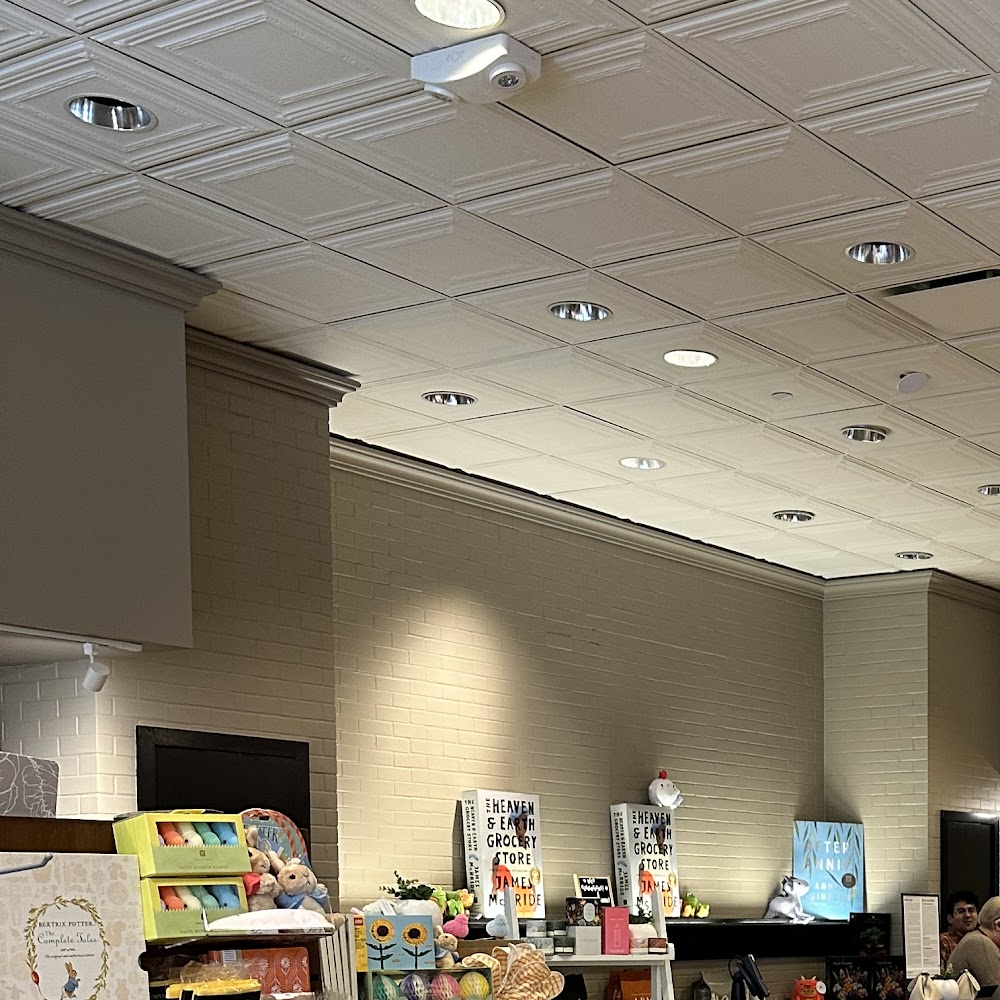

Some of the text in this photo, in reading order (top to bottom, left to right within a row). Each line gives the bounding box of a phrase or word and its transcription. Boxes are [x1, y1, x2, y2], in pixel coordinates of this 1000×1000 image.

[492, 798, 534, 815] HEAVEN
[488, 816, 534, 831] & EARTH
[638, 811, 671, 825] HEAVEN
[634, 828, 640, 838] &
[487, 832, 537, 850] GROCERY
[634, 842, 673, 856] GROCERY
[495, 852, 531, 865] STORE
[640, 858, 670, 871] STORE
[496, 876, 532, 890] JAMES
[642, 880, 671, 893] JAMES
[489, 894, 542, 906] McRIDE
[38, 932, 97, 946] Complete Tales
